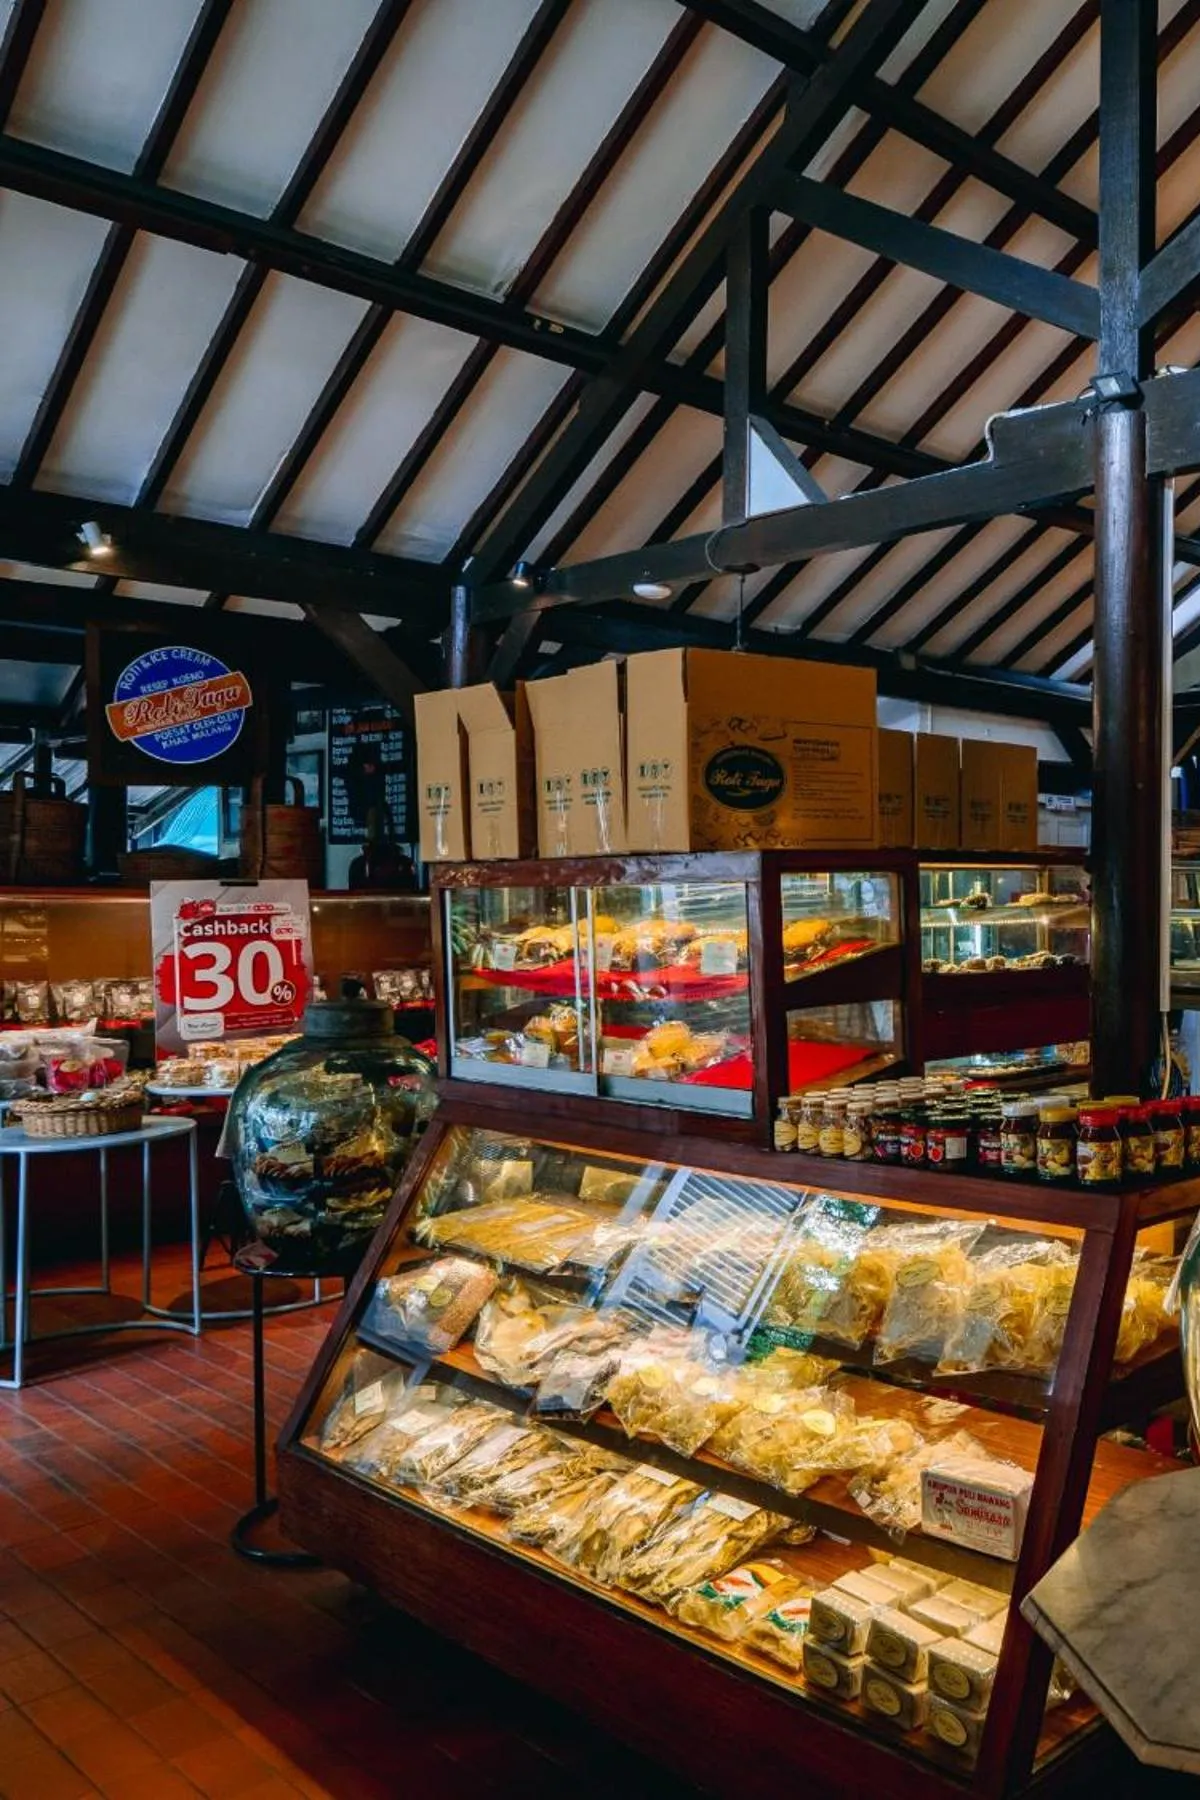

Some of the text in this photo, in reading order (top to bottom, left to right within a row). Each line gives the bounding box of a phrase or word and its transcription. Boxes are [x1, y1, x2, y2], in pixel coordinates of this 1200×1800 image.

[120, 664, 142, 690] ROTI
[151, 651, 169, 663] ICE
[171, 649, 212, 666] CREAM
[179, 919, 270, 937] Cashback
